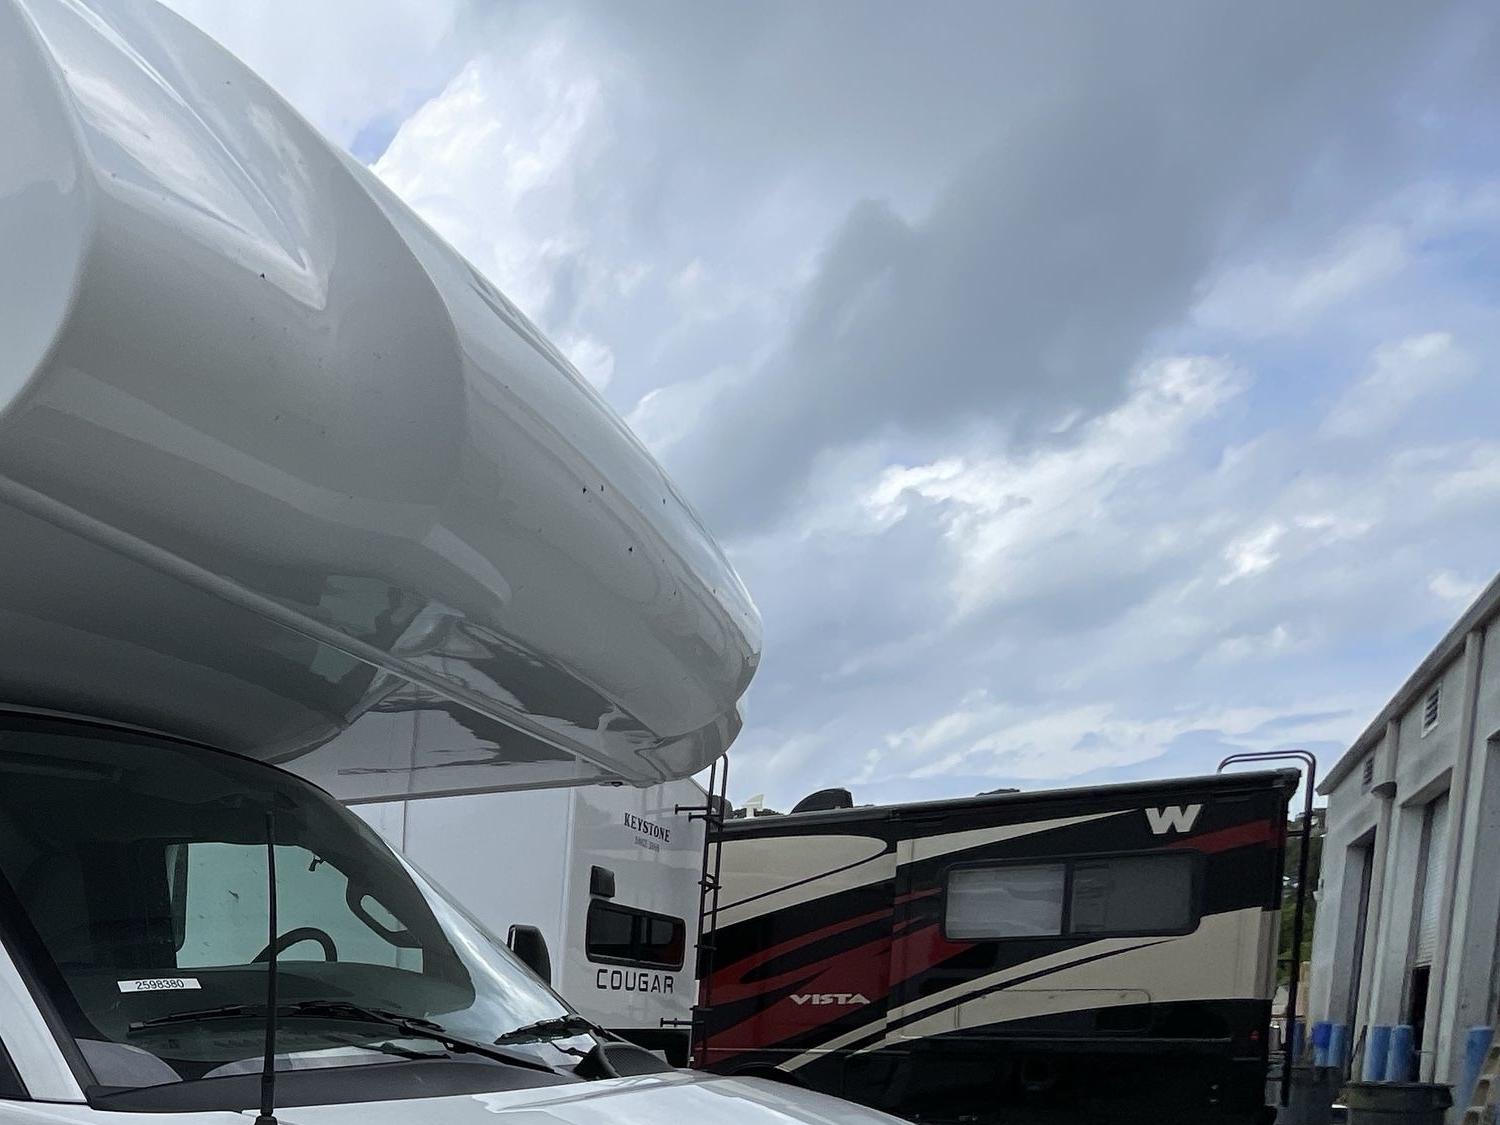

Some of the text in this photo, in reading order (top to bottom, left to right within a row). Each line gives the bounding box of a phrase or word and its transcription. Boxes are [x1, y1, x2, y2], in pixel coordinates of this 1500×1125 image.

[624, 812, 671, 843] KEYSTONE
[1145, 804, 1204, 834] W
[135, 979, 185, 990] 2598380
[596, 968, 674, 994] COUGAR
[789, 993, 871, 1006] VISTA
